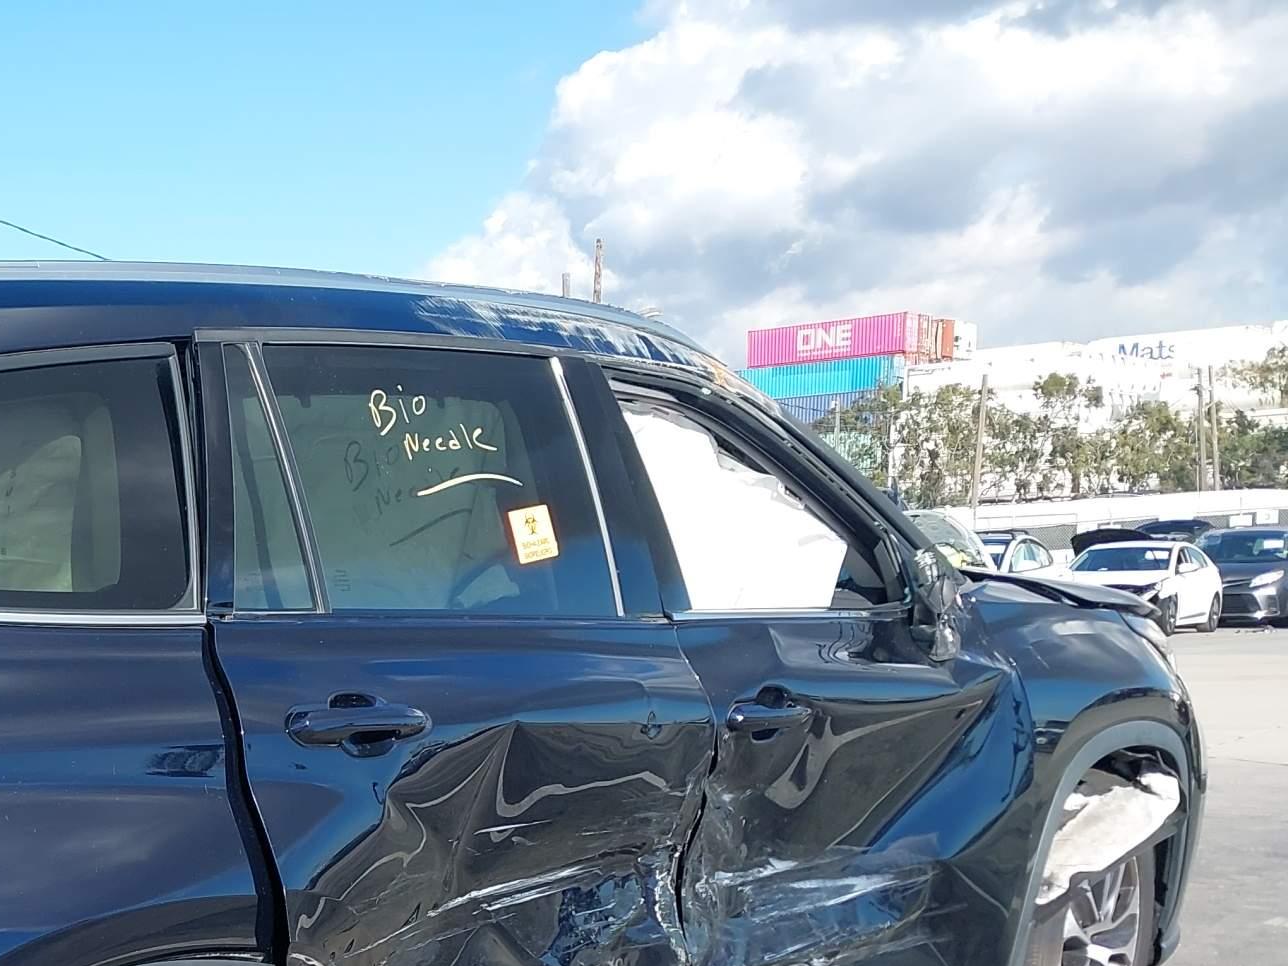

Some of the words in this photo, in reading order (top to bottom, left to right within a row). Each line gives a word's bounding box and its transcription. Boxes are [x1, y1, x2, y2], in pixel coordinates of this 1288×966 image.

[797, 323, 853, 351] ONE
[368, 385, 426, 436] Bio
[403, 424, 498, 461] Needle
